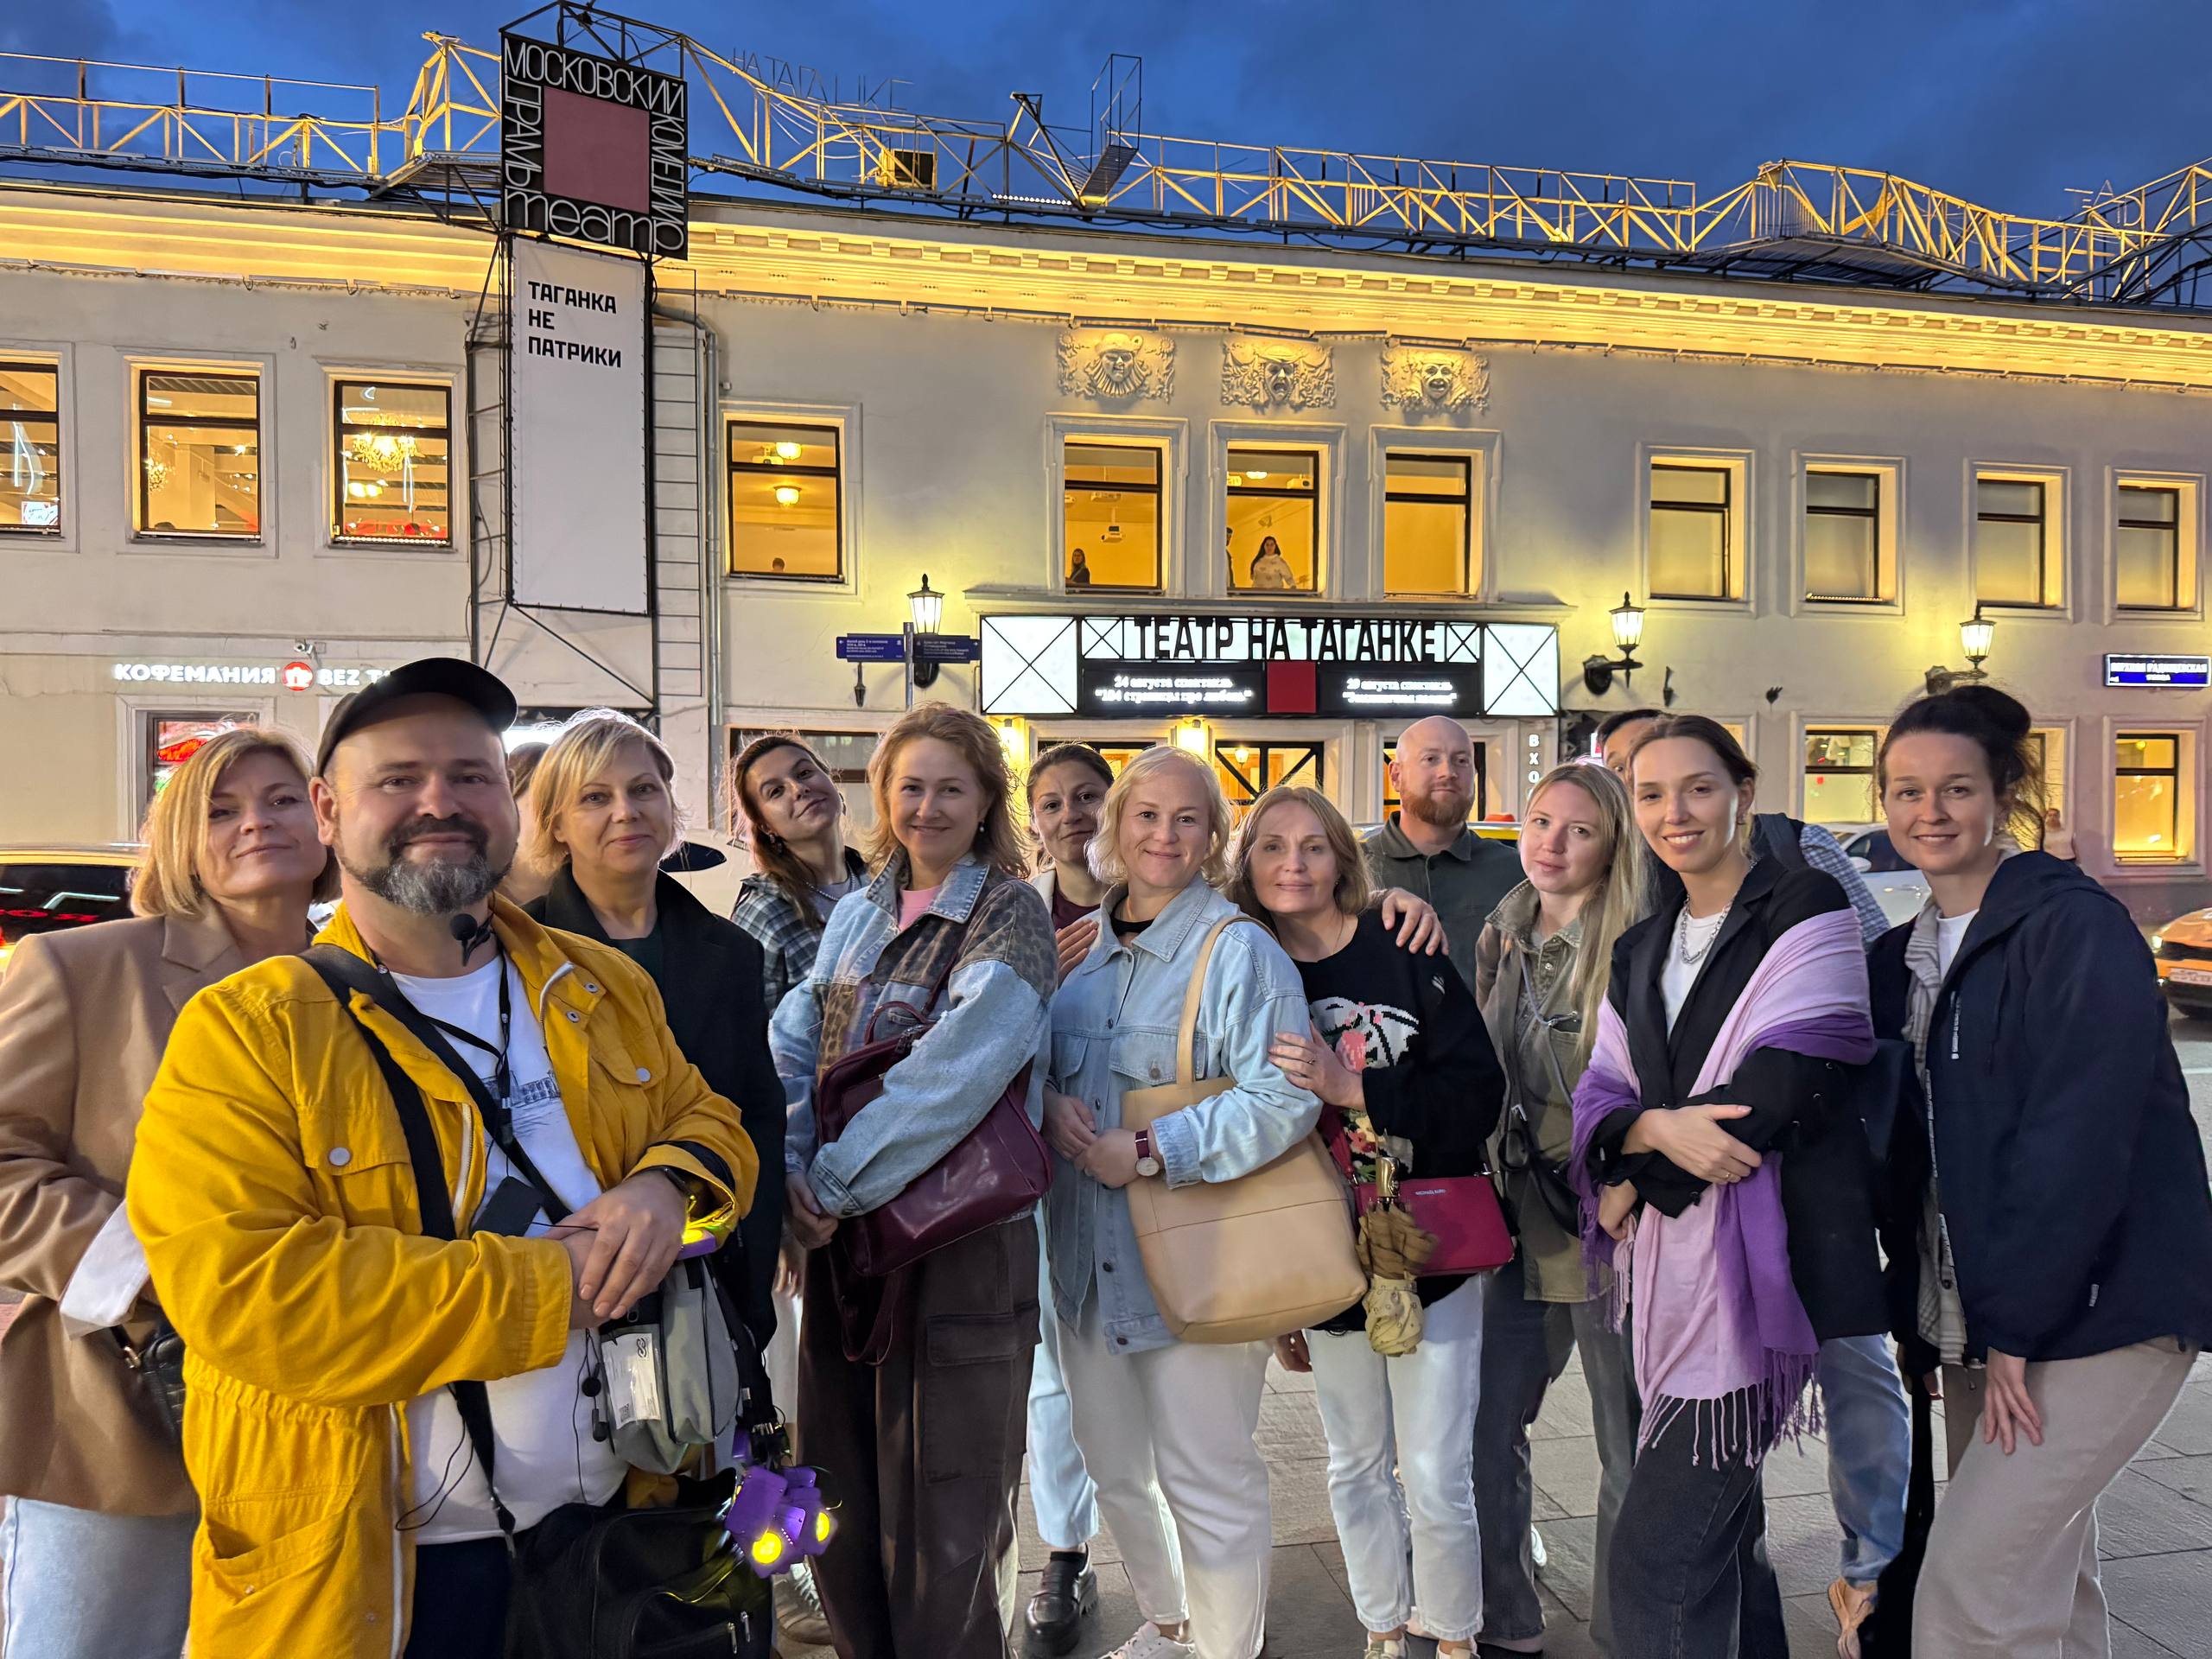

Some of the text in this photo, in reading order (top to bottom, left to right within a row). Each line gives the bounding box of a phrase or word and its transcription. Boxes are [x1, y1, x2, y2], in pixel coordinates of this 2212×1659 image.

[504, 38, 685, 118] МОСКОВСКИЙ
[505, 74, 543, 194] ДРАМЫ
[651, 111, 685, 226] КОМЕДИИ
[528, 281, 616, 315] ТАГАНКА
[529, 308, 555, 330] НЕ
[529, 336, 621, 368] ПАТРИКИ
[1135, 617, 1435, 662] ТЕАТР НА ТАГАНКЕ
[113, 664, 276, 684] КОФЕМАНИЯ
[317, 669, 360, 686] BEZ
